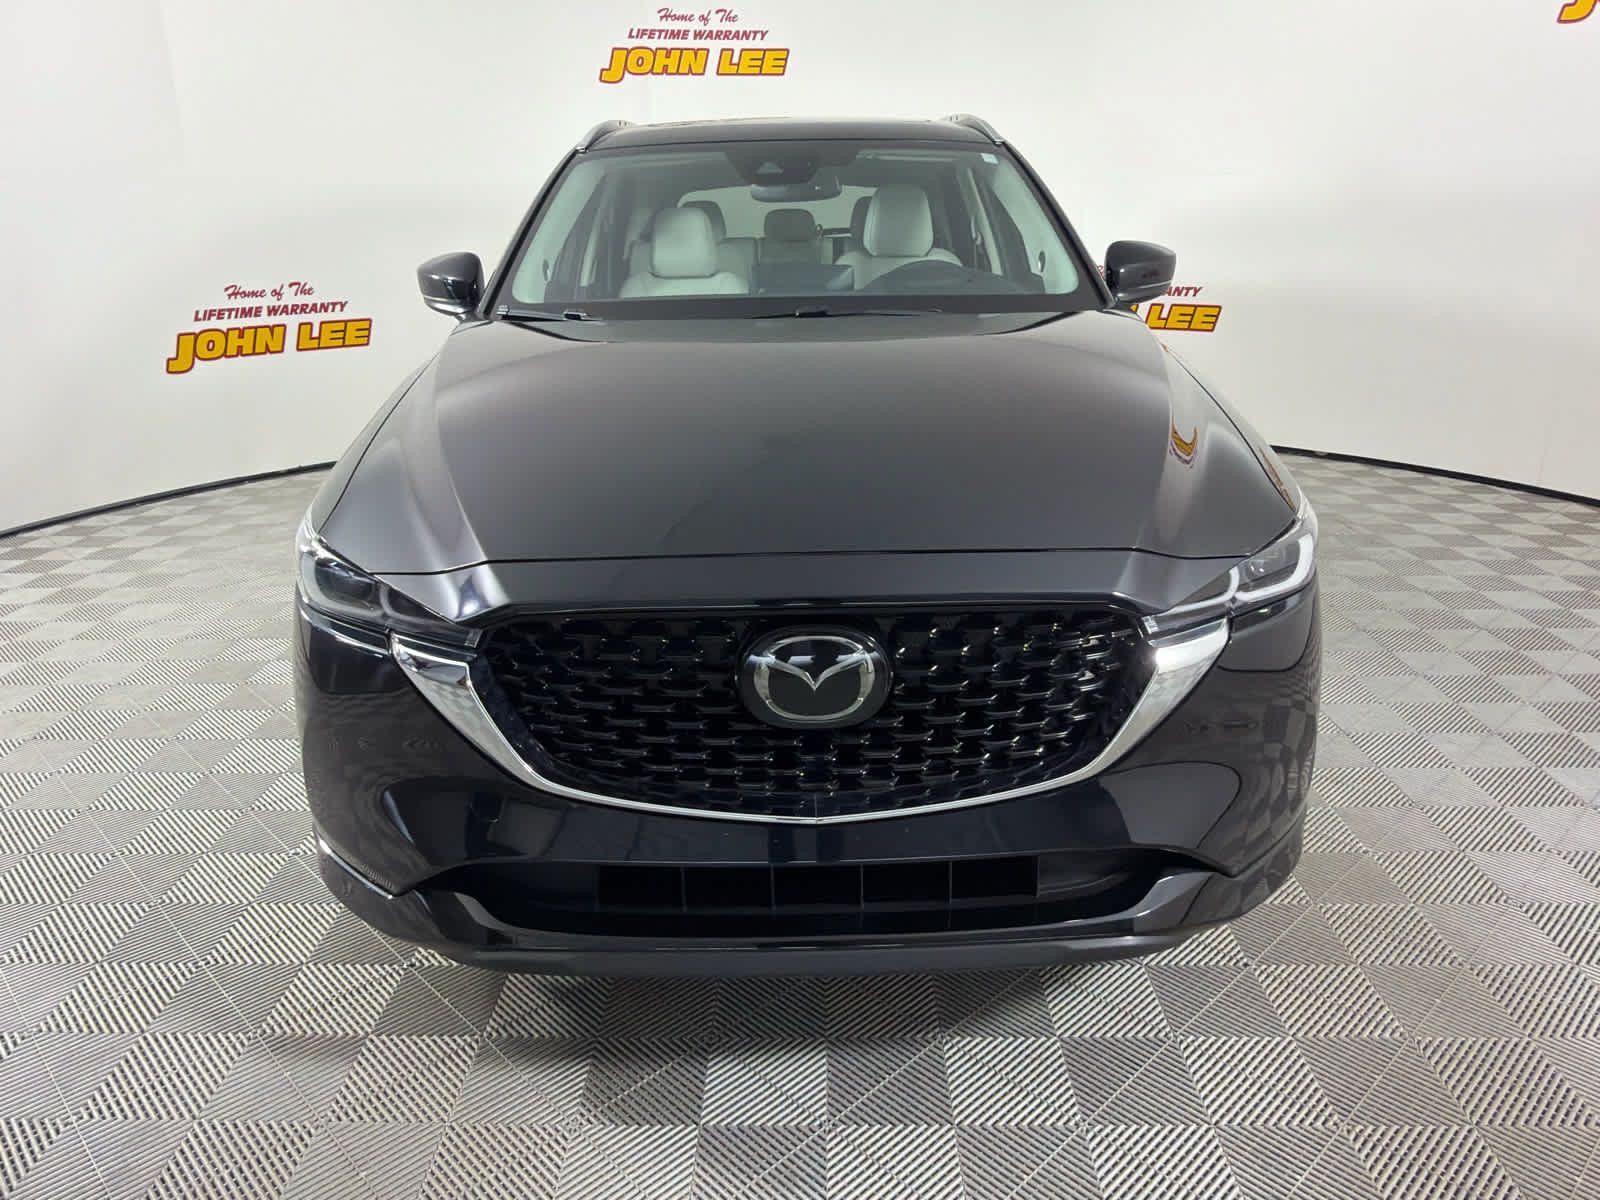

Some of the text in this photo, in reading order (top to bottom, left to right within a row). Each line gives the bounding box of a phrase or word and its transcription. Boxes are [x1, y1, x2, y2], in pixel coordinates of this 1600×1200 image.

[657, 8, 739, 26] Home of The
[628, 28, 769, 41] LIFETIME WARRANTY
[599, 46, 790, 83] JOHN LEE
[224, 281, 315, 301] Home of The
[193, 301, 348, 322] LIFETIME WARRANTY
[1145, 303, 1222, 333] LEE
[166, 318, 373, 374] JOHN LEE
